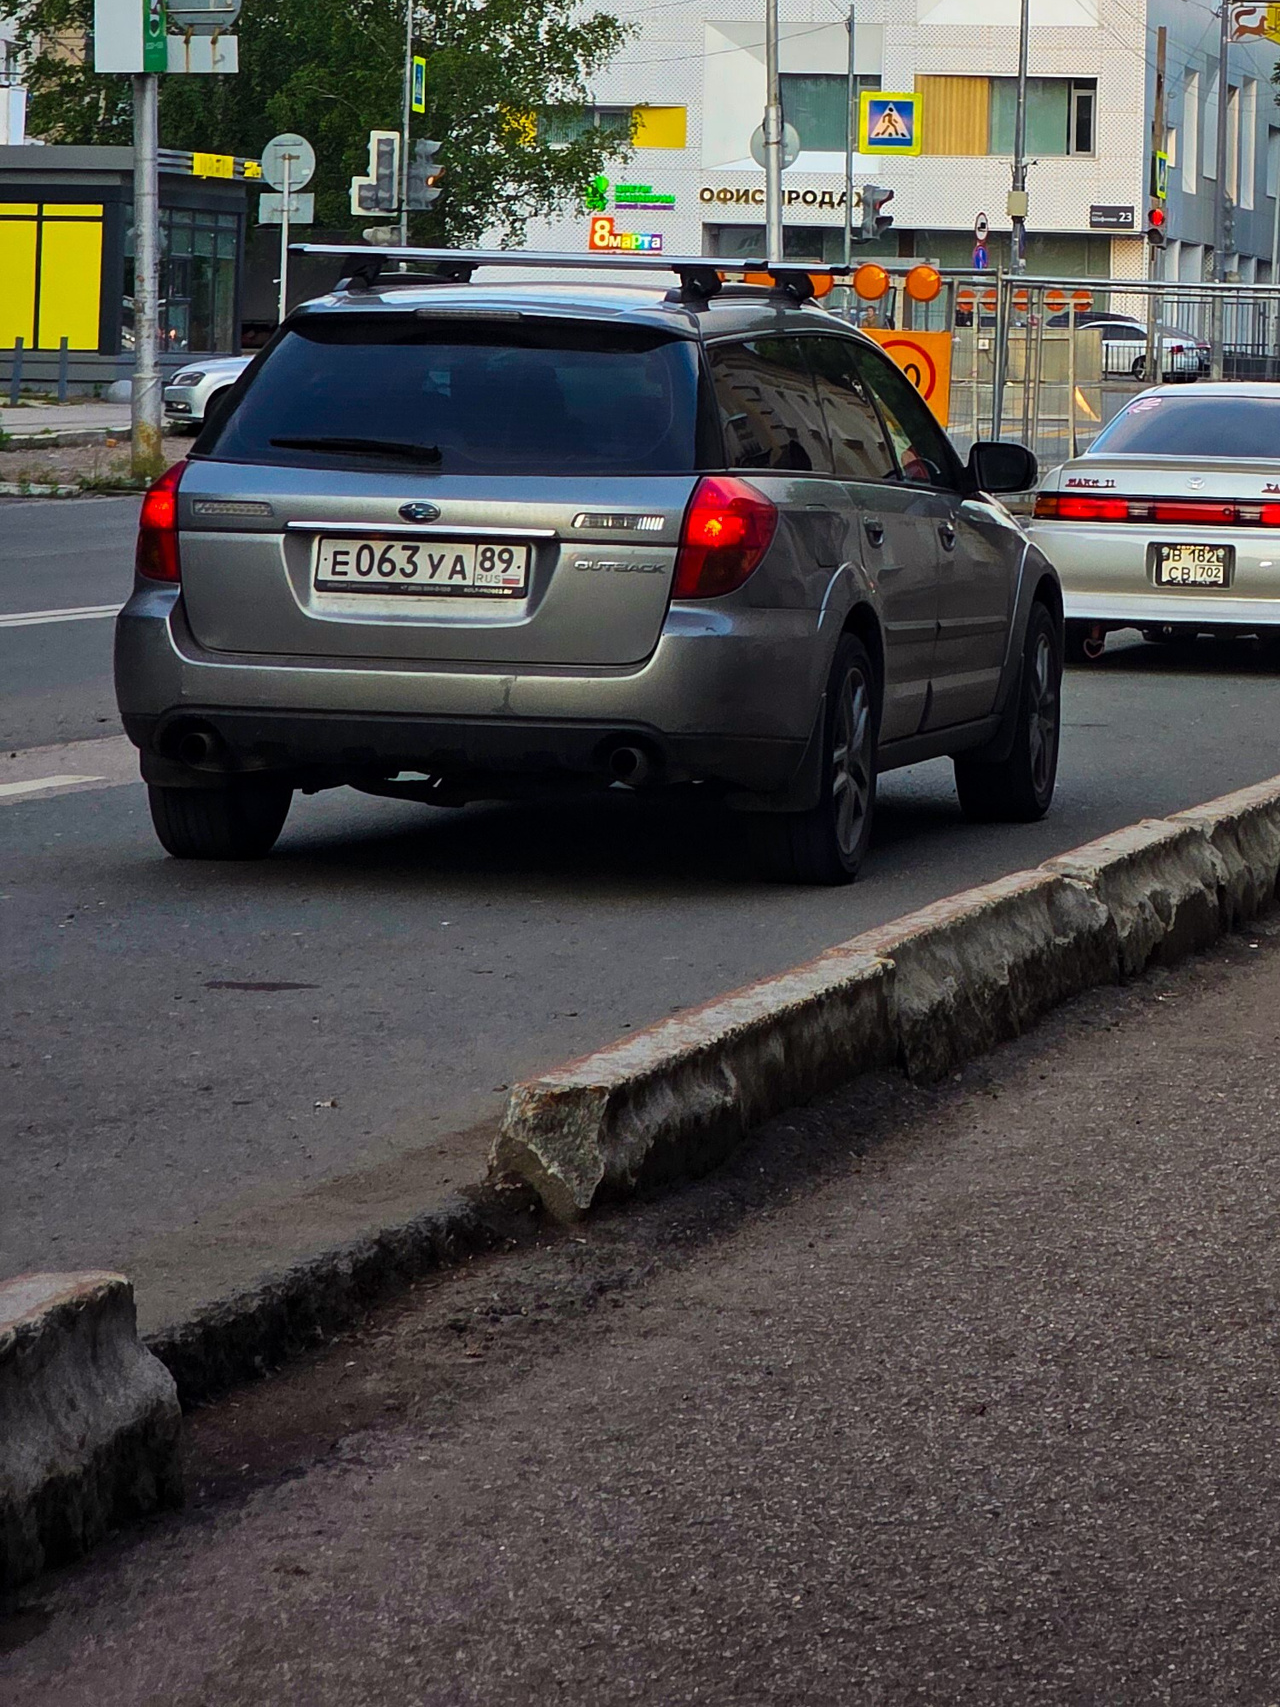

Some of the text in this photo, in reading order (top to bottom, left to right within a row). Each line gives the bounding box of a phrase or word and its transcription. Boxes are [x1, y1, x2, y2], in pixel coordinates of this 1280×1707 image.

[699, 186, 765, 206] ОФИС
[1118, 211, 1133, 223] 23
[478, 547, 515, 574] 89
[573, 560, 666, 574] OUTBACK
[476, 573, 501, 584] RUS
[1198, 566, 1221, 579] 702
